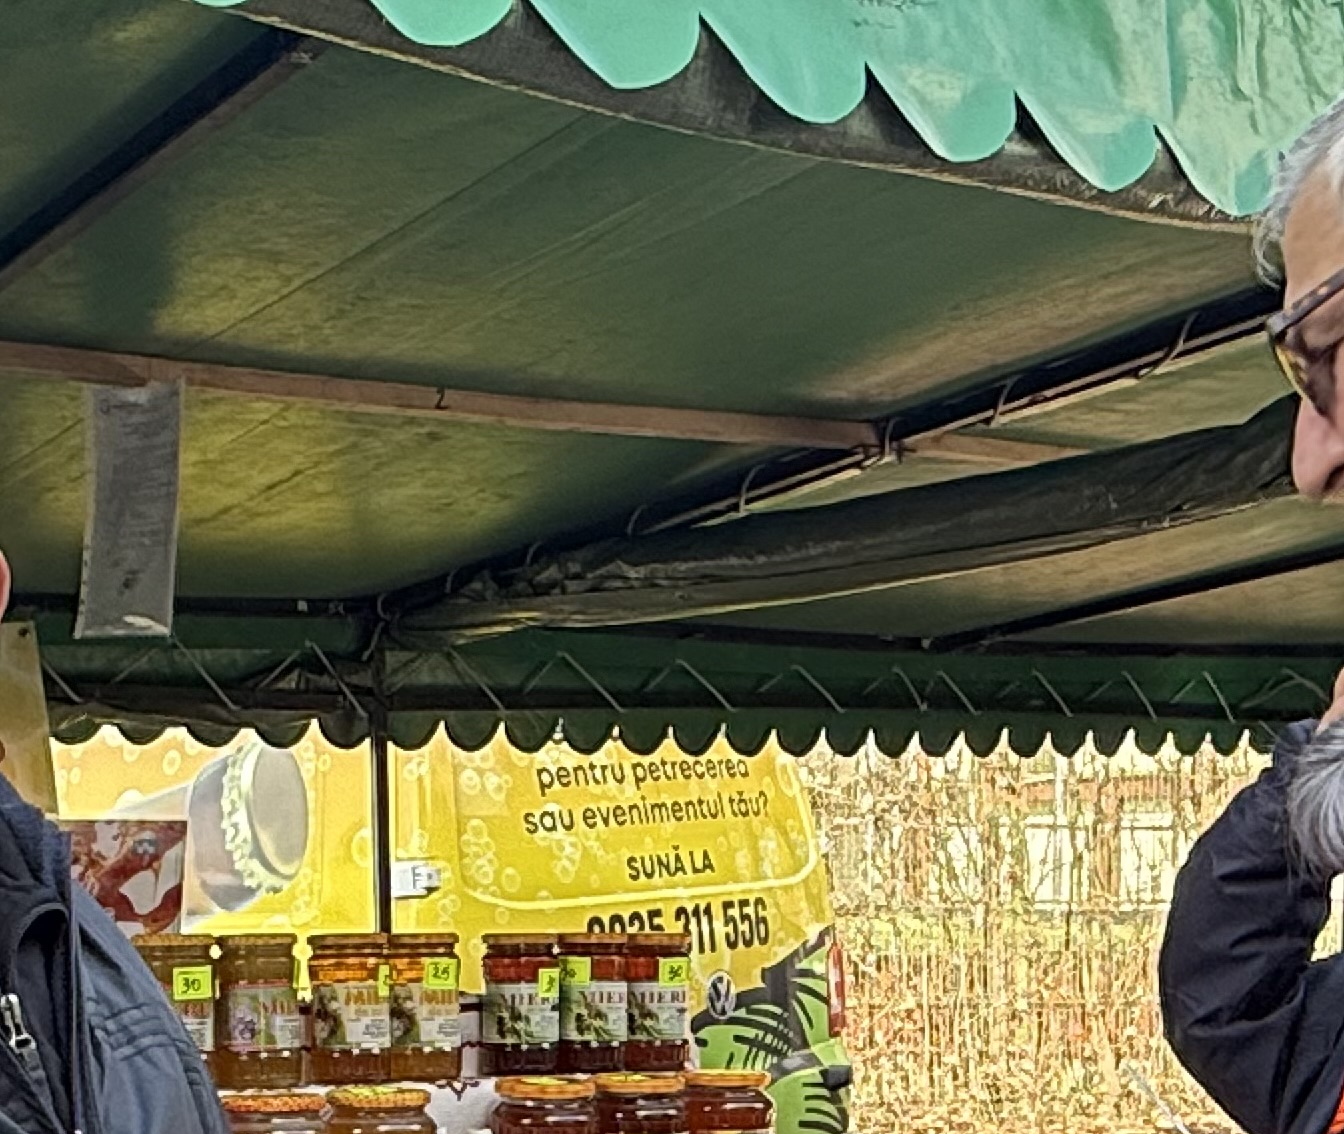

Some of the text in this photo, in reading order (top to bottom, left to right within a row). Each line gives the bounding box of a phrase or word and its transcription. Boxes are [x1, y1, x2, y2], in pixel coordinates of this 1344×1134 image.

[536, 757, 750, 797] pentru petrecerea
[523, 790, 769, 834] sau evenimentul tău?
[626, 844, 716, 882] SUNĂ LA
[722, 896, 770, 950] 556
[180, 976, 202, 994] 30
